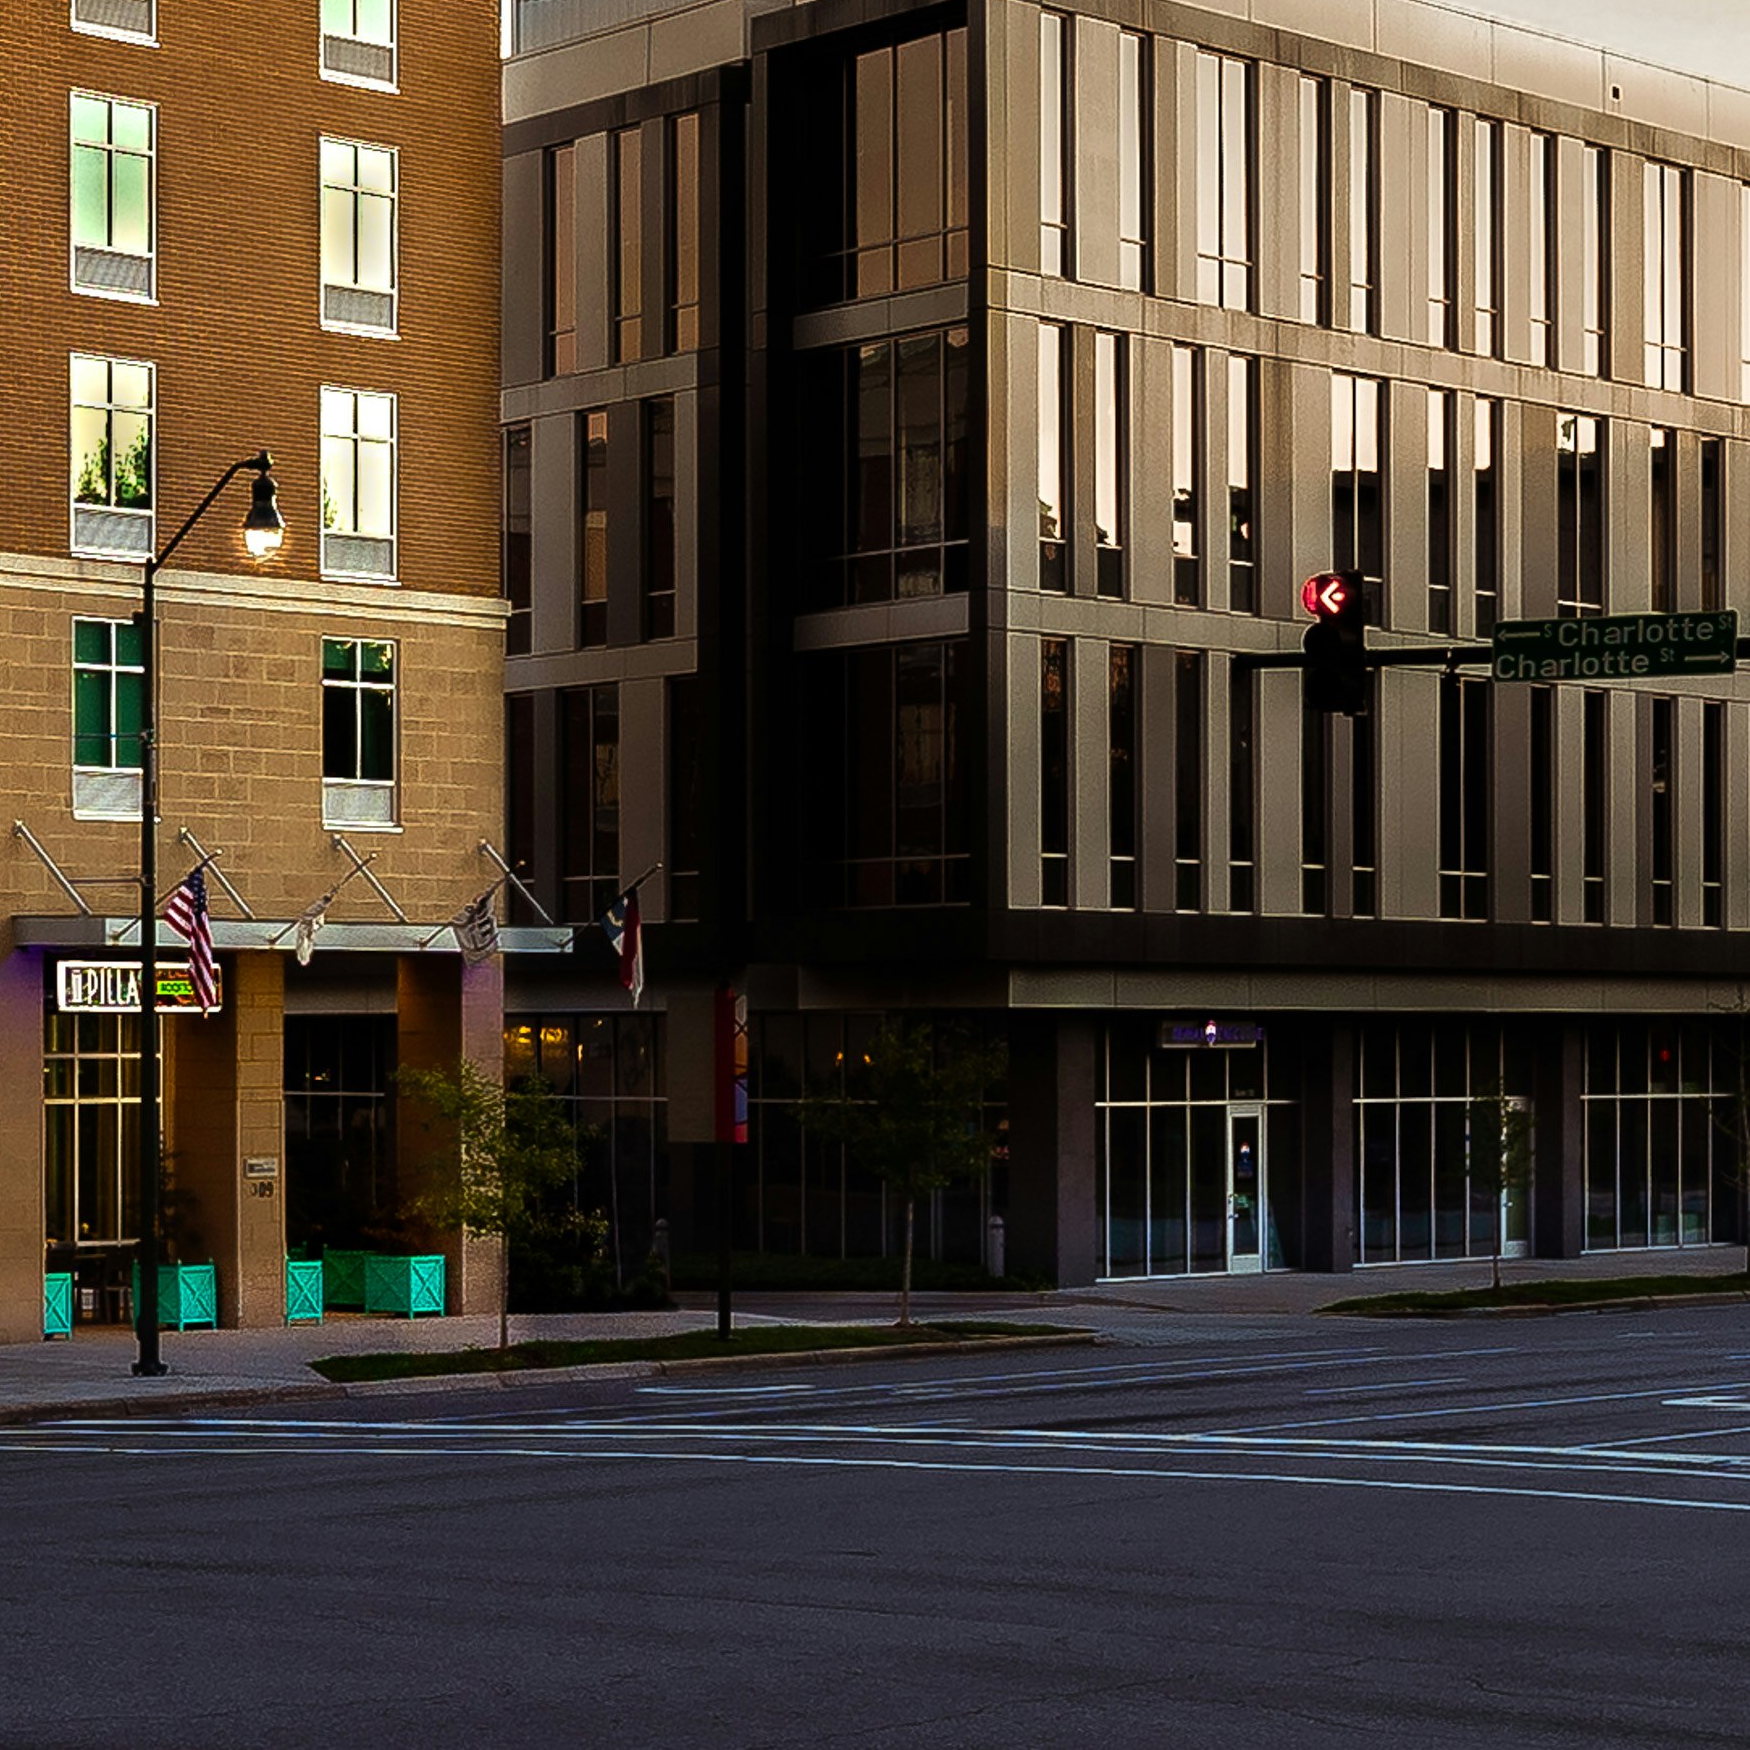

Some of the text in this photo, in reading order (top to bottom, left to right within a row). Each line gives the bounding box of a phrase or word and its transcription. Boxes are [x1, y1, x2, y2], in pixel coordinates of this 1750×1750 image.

[1543, 614, 1733, 646] S Charlotte St
[1496, 648, 1675, 679] Charlotte St
[86, 968, 142, 1005] PILLA
